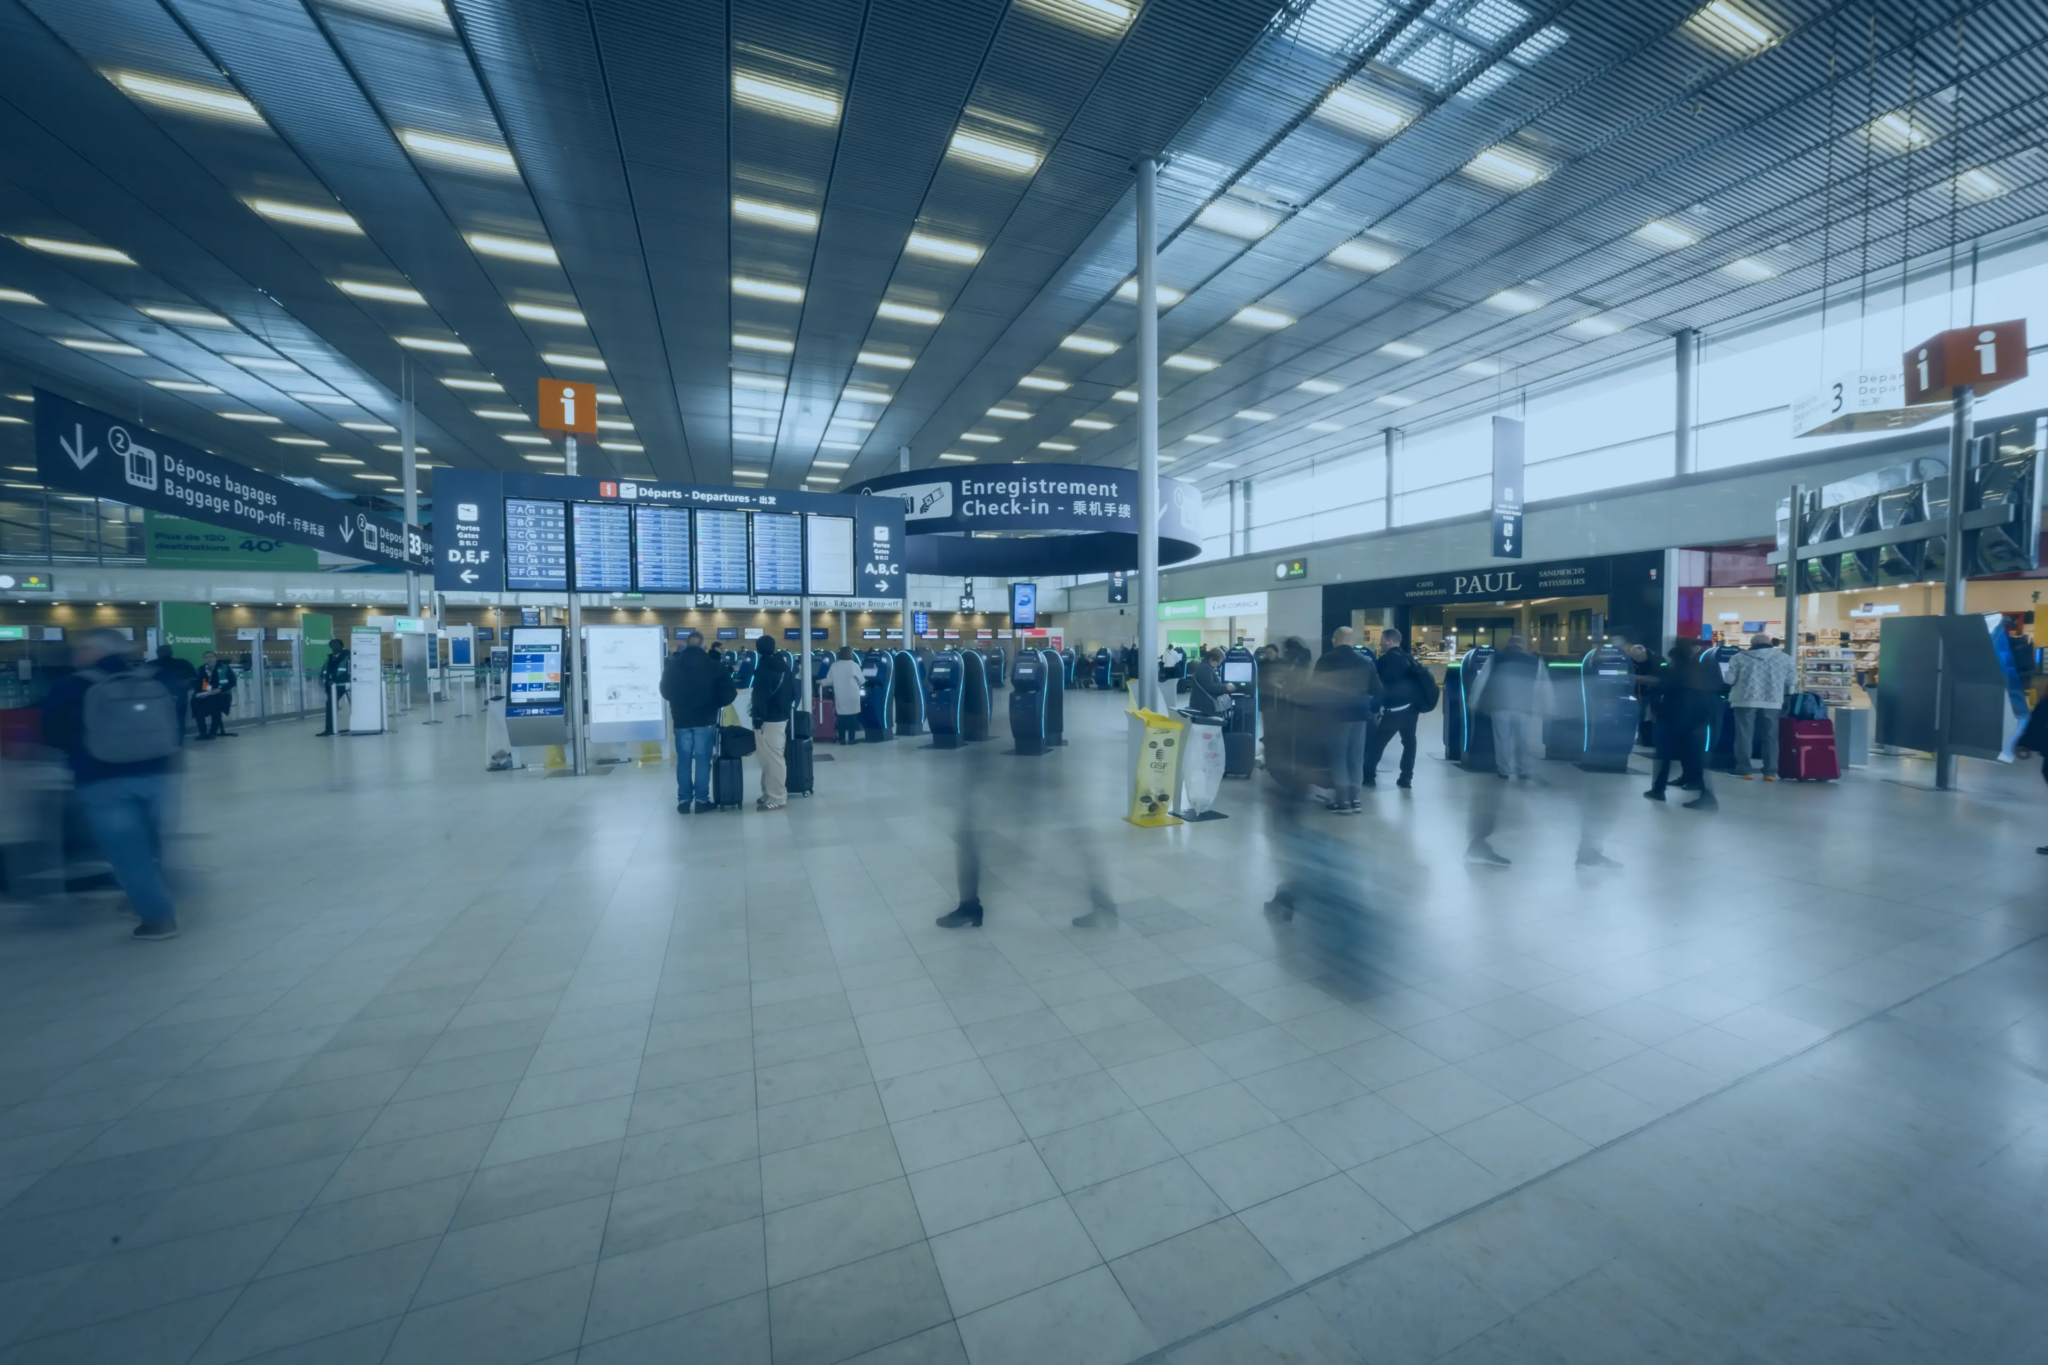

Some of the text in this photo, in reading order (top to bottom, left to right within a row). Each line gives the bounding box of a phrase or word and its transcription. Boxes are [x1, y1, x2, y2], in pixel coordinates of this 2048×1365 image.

[1859, 372, 1905, 386] Dépar
[1859, 383, 1905, 396] Depar
[1831, 382, 1843, 413] 3
[115, 433, 126, 450] 2
[163, 454, 278, 507] Dépose bagages
[961, 477, 1119, 498] Enregistrement
[639, 487, 682, 499] Départs
[692, 491, 750, 502] Departures
[759, 496, 777, 505] 出发
[164, 478, 231, 513] Baggage
[234, 499, 286, 528] Drop-off
[293, 517, 326, 538] 行李托运
[517, 506, 524, 514] A
[962, 498, 1050, 517] Check-in
[1073, 500, 1132, 519] 乘机手续
[456, 524, 480, 532] Portes
[155, 532, 226, 542] Plus de 120
[517, 531, 525, 539] C
[155, 542, 230, 552] destinations
[380, 541, 406, 560] Bagga
[409, 533, 422, 556] 33
[448, 549, 490, 565] D,E,F
[518, 556, 525, 564] E
[518, 568, 525, 576] F
[864, 563, 899, 575] A,B,C
[1453, 571, 1523, 595] PAUL
[697, 594, 713, 605] 34
[795, 599, 826, 607] bages
[833, 600, 866, 608] Baggage
[961, 598, 974, 609] 34
